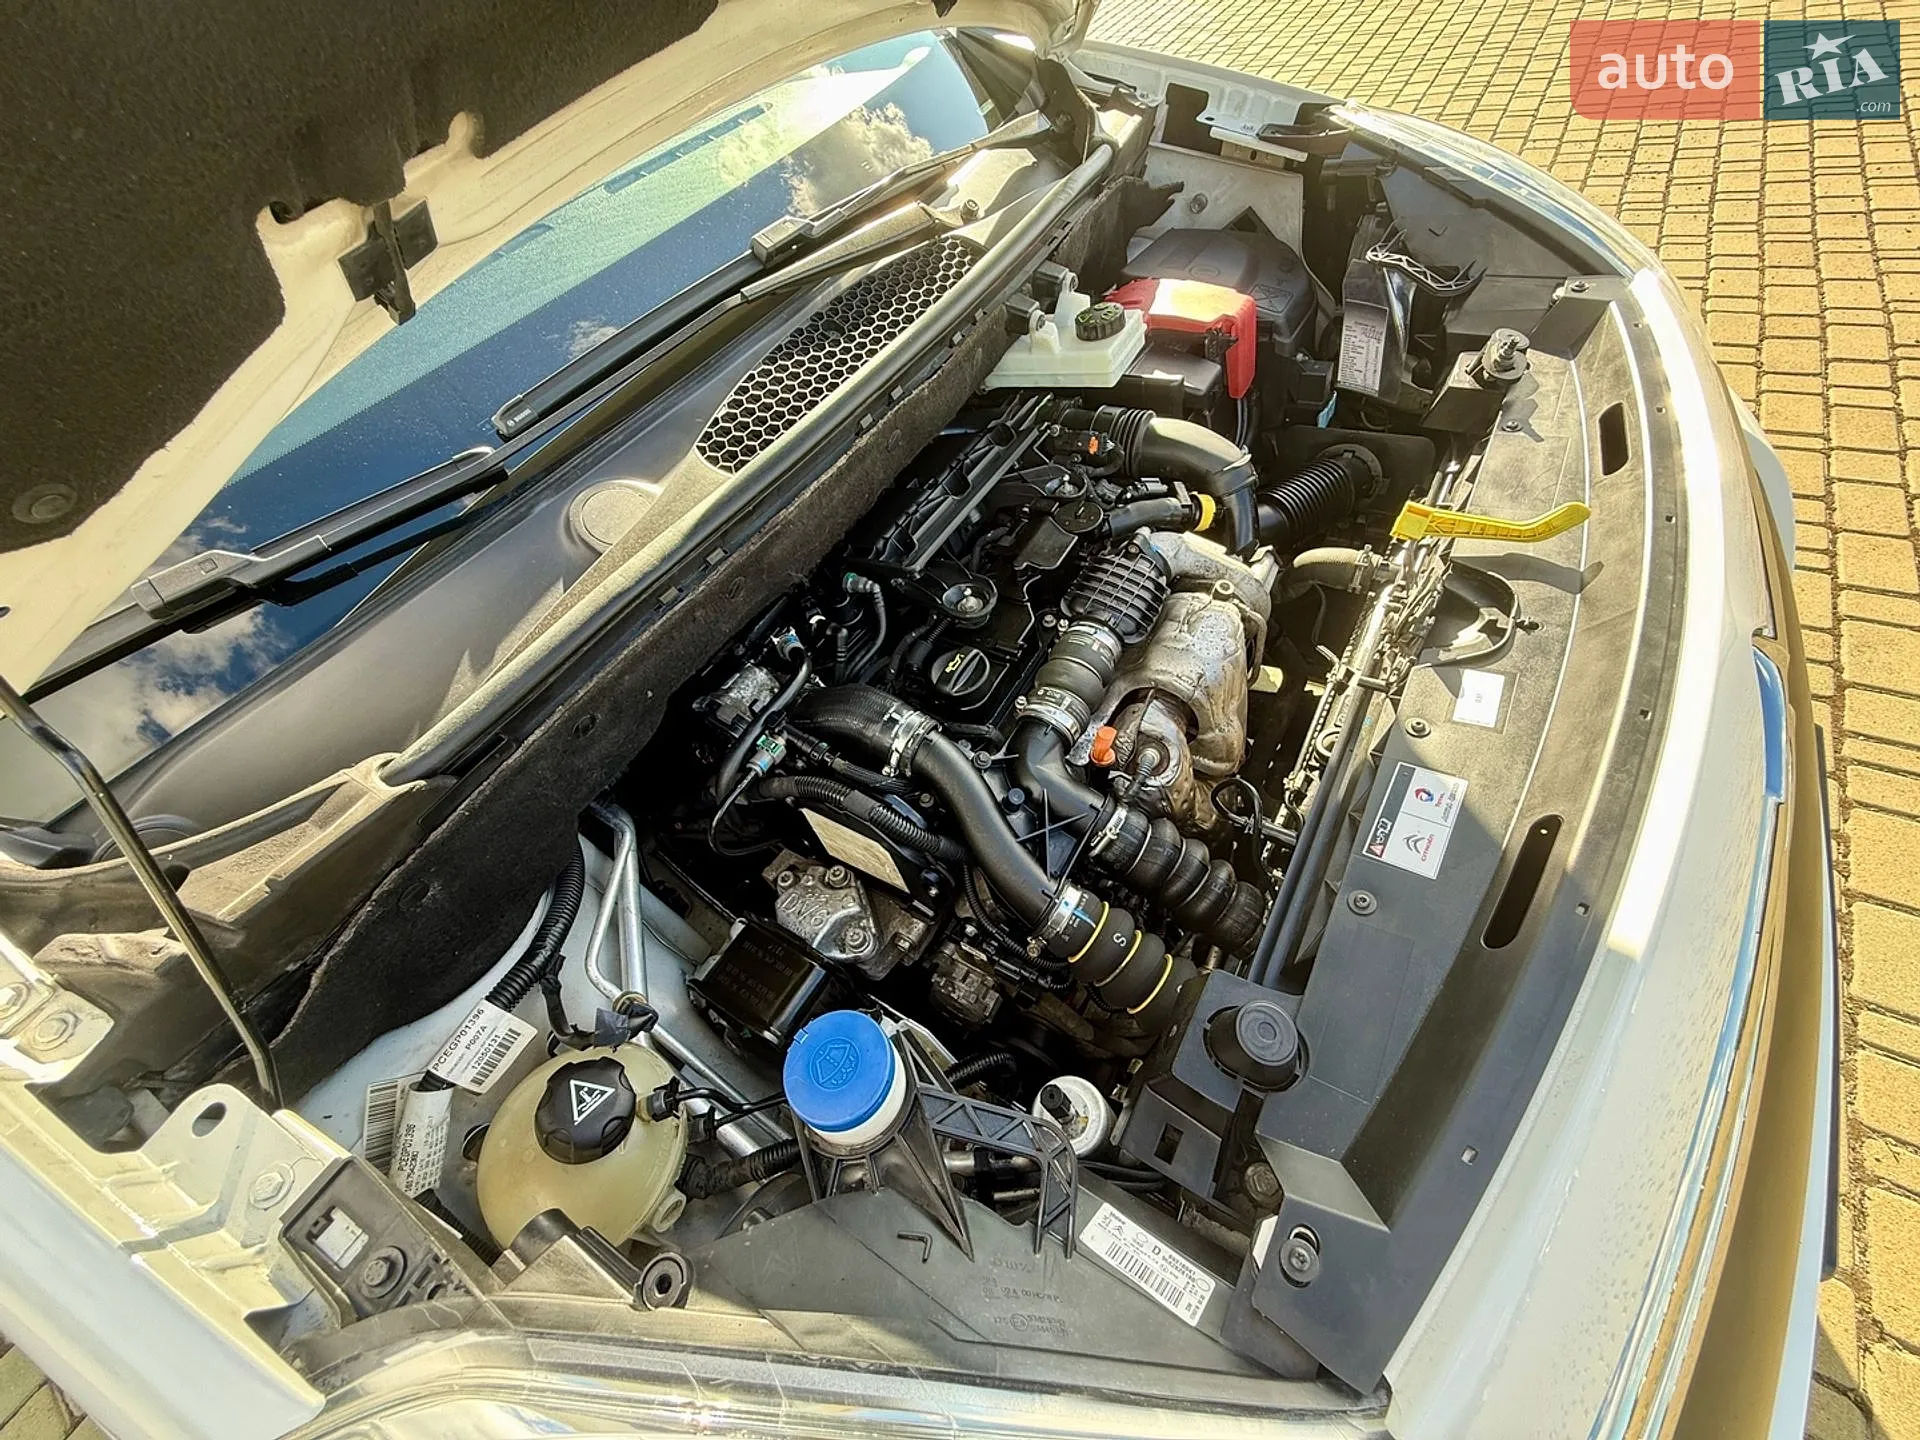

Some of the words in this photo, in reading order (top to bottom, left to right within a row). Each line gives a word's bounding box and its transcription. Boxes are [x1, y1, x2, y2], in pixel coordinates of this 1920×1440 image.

[1113, 933, 1127, 947] S
[431, 1008, 485, 1072] PCEGP01396
[471, 1034, 501, 1070] 12050131
[1151, 1245, 1162, 1256] D
